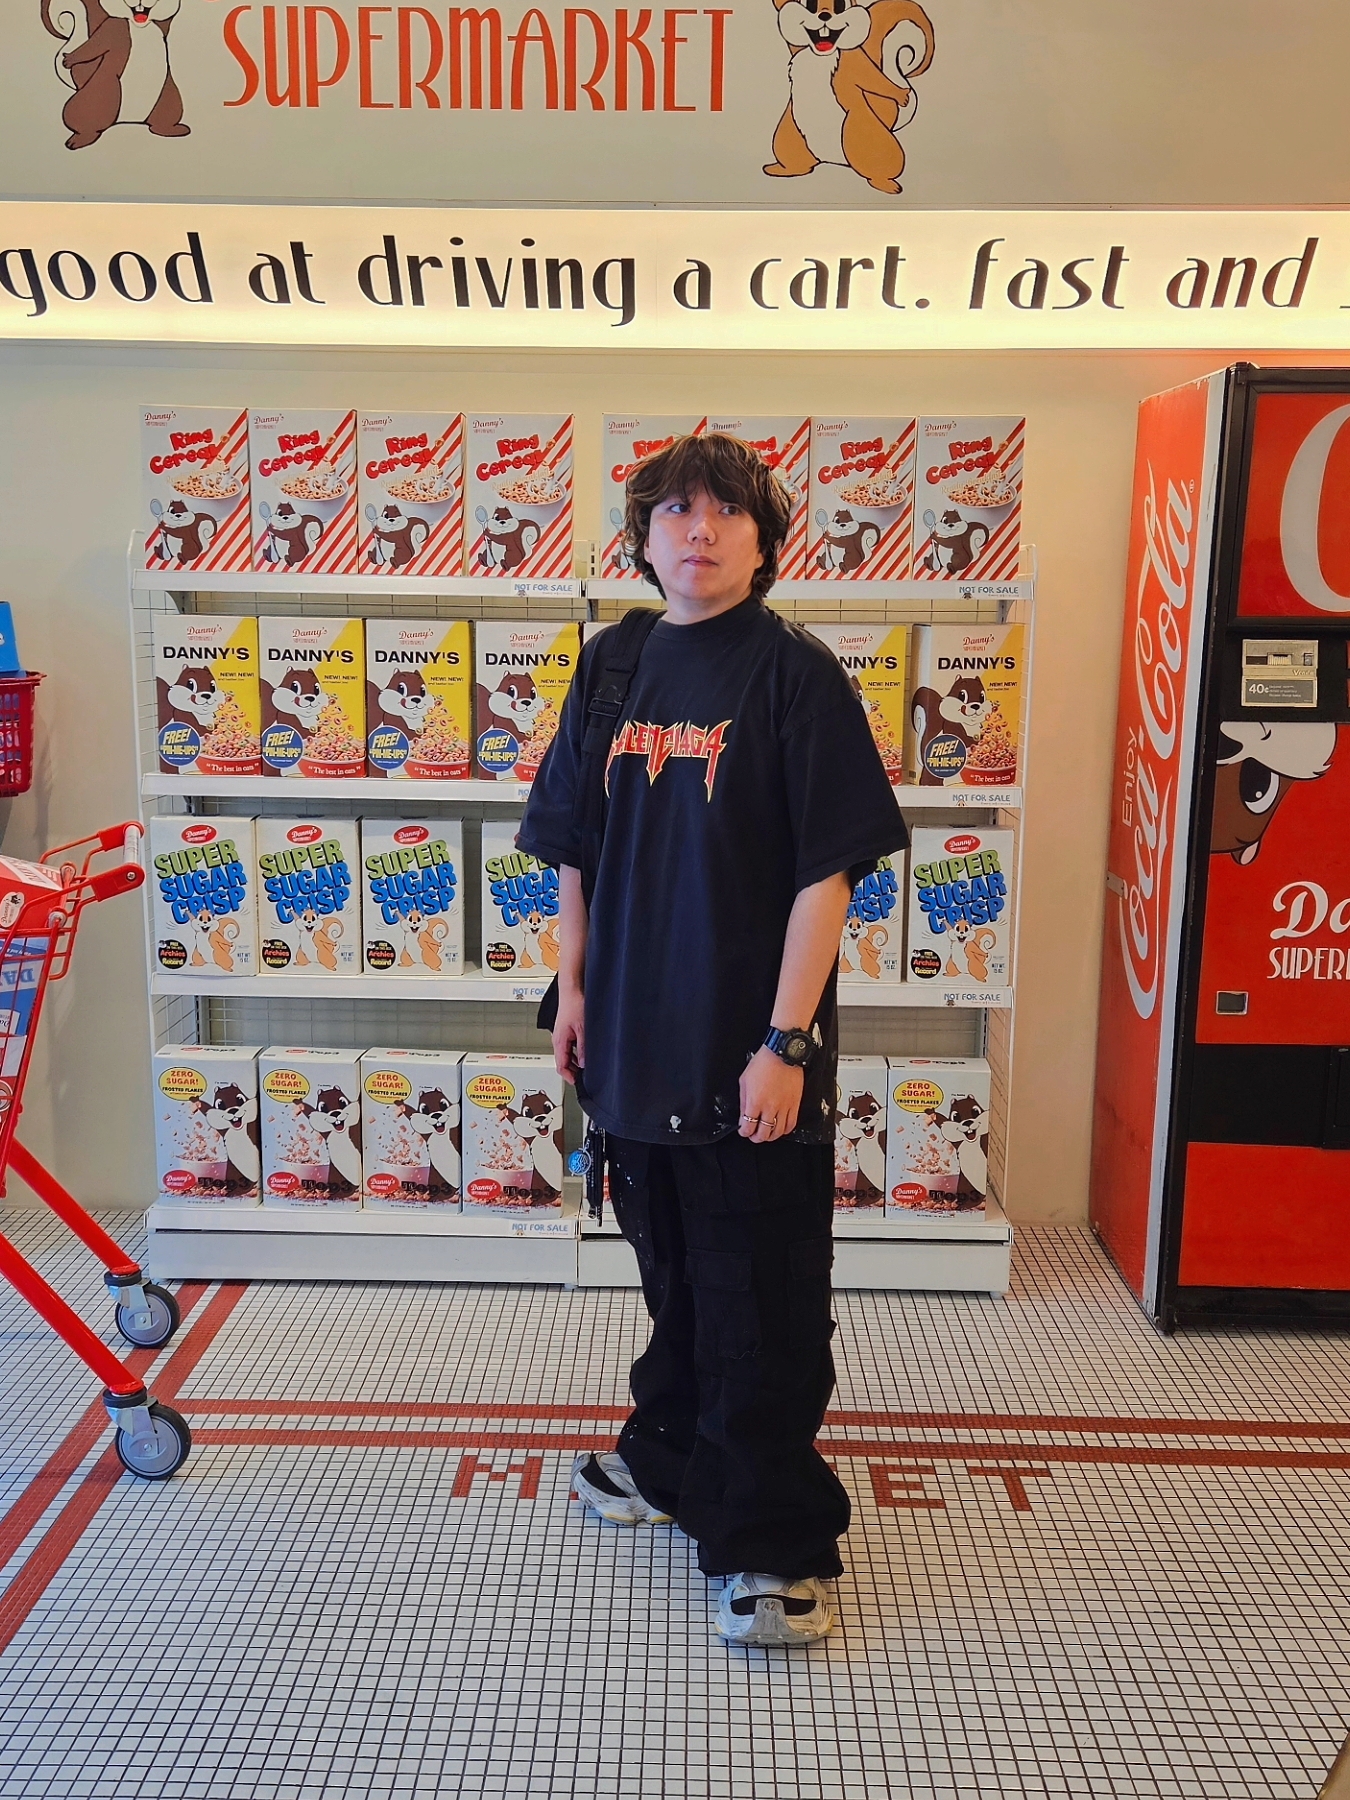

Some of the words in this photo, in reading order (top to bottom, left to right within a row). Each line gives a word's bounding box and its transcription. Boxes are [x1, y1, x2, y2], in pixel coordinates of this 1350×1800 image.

[223, 5, 733, 112] SUPERMARKET
[0, 232, 213, 317] good
[249, 241, 326, 305] at
[358, 235, 635, 327] driving
[673, 258, 711, 310] a
[750, 245, 930, 310] cart.
[968, 238, 1130, 310] fast
[1166, 237, 1320, 309] and
[145, 411, 177, 421] Danny's
[253, 413, 284, 425] Danny's
[361, 415, 393, 427] Danny's
[472, 418, 504, 429] Danny's
[608, 419, 640, 430] Danny's
[816, 420, 849, 432] Danny's
[924, 420, 957, 432] Danny's
[169, 428, 214, 451] Ring
[277, 430, 320, 453] Ring
[385, 433, 428, 456] Ring
[496, 434, 539, 457] Ring
[840, 436, 883, 461] Ring
[948, 436, 993, 460] Ring
[149, 444, 217, 474] Cereal
[258, 445, 325, 477] Cereal
[365, 447, 432, 480] Cereal
[476, 449, 544, 482] Cereal
[818, 452, 886, 484] Cereal
[926, 451, 995, 485] Cereal
[514, 583, 531, 591] NOT
[532, 583, 548, 591] FOR
[550, 584, 573, 592] SALE
[959, 585, 977, 594] NOT
[977, 586, 994, 594] FOR
[995, 586, 1019, 594] SALE
[186, 624, 223, 636] Danny's
[292, 627, 328, 638] Danny's
[398, 628, 434, 640] Danny's
[509, 630, 545, 642] Danny's
[837, 633, 874, 645] Danny's
[963, 633, 995, 645] Danny's
[163, 647, 250, 660] DANNY'S
[268, 648, 354, 663] DANNY'S
[375, 650, 460, 665] DANNY'S
[485, 653, 570, 667] DANNY'S
[839, 656, 898, 669] NNY'S
[937, 657, 1015, 670] DANNY'S
[163, 728, 192, 745] FREE!
[265, 730, 295, 747] FREE!
[372, 732, 401, 748] FREE!
[481, 735, 510, 751] FREE!
[1119, 458, 1193, 1019] Coca-Cola
[929, 740, 959, 757] FREE!
[1121, 726, 1138, 828] Enjoy
[185, 827, 212, 838] Danny's
[291, 827, 318, 838] Danny's
[398, 828, 424, 838] Danny's
[949, 837, 976, 848] Danny's
[155, 839, 241, 880] SUPER
[259, 839, 345, 878] SUPER
[365, 839, 450, 880] SUPER
[485, 852, 550, 883] SUP
[914, 849, 1002, 888] SUPER
[159, 862, 248, 903] SUGAR
[264, 862, 352, 902] SUGAR
[370, 862, 457, 903] SUGAR
[490, 867, 560, 906] SUGA
[918, 872, 1008, 912] SUGAR
[171, 886, 246, 924] CRISP
[276, 886, 350, 924] CRISP
[381, 887, 455, 926] CRISP
[501, 891, 560, 927] CRIS
[928, 897, 1005, 934] CRISP
[368, 950, 394, 959] Archies
[488, 952, 514, 960] Archies
[944, 993, 960, 1001] NOT
[961, 993, 976, 1001] FOR
[166, 1077, 199, 1086] SUGAR!
[274, 1072, 296, 1080] ZERO
[376, 1073, 399, 1081] ZERO
[270, 1080, 302, 1088] SUGAR!
[372, 1080, 404, 1090] SUGAR!
[474, 1085, 507, 1093] SUGAR!
[901, 1090, 935, 1098] SUGAR!
[165, 1174, 192, 1182] Danny's
[270, 1177, 295, 1185] Danny's
[370, 1177, 396, 1186] Danny's
[471, 1183, 497, 1191] Danny's
[895, 1187, 923, 1196] Danny's
[512, 1223, 528, 1231] NOT
[547, 1224, 568, 1232] SALE
